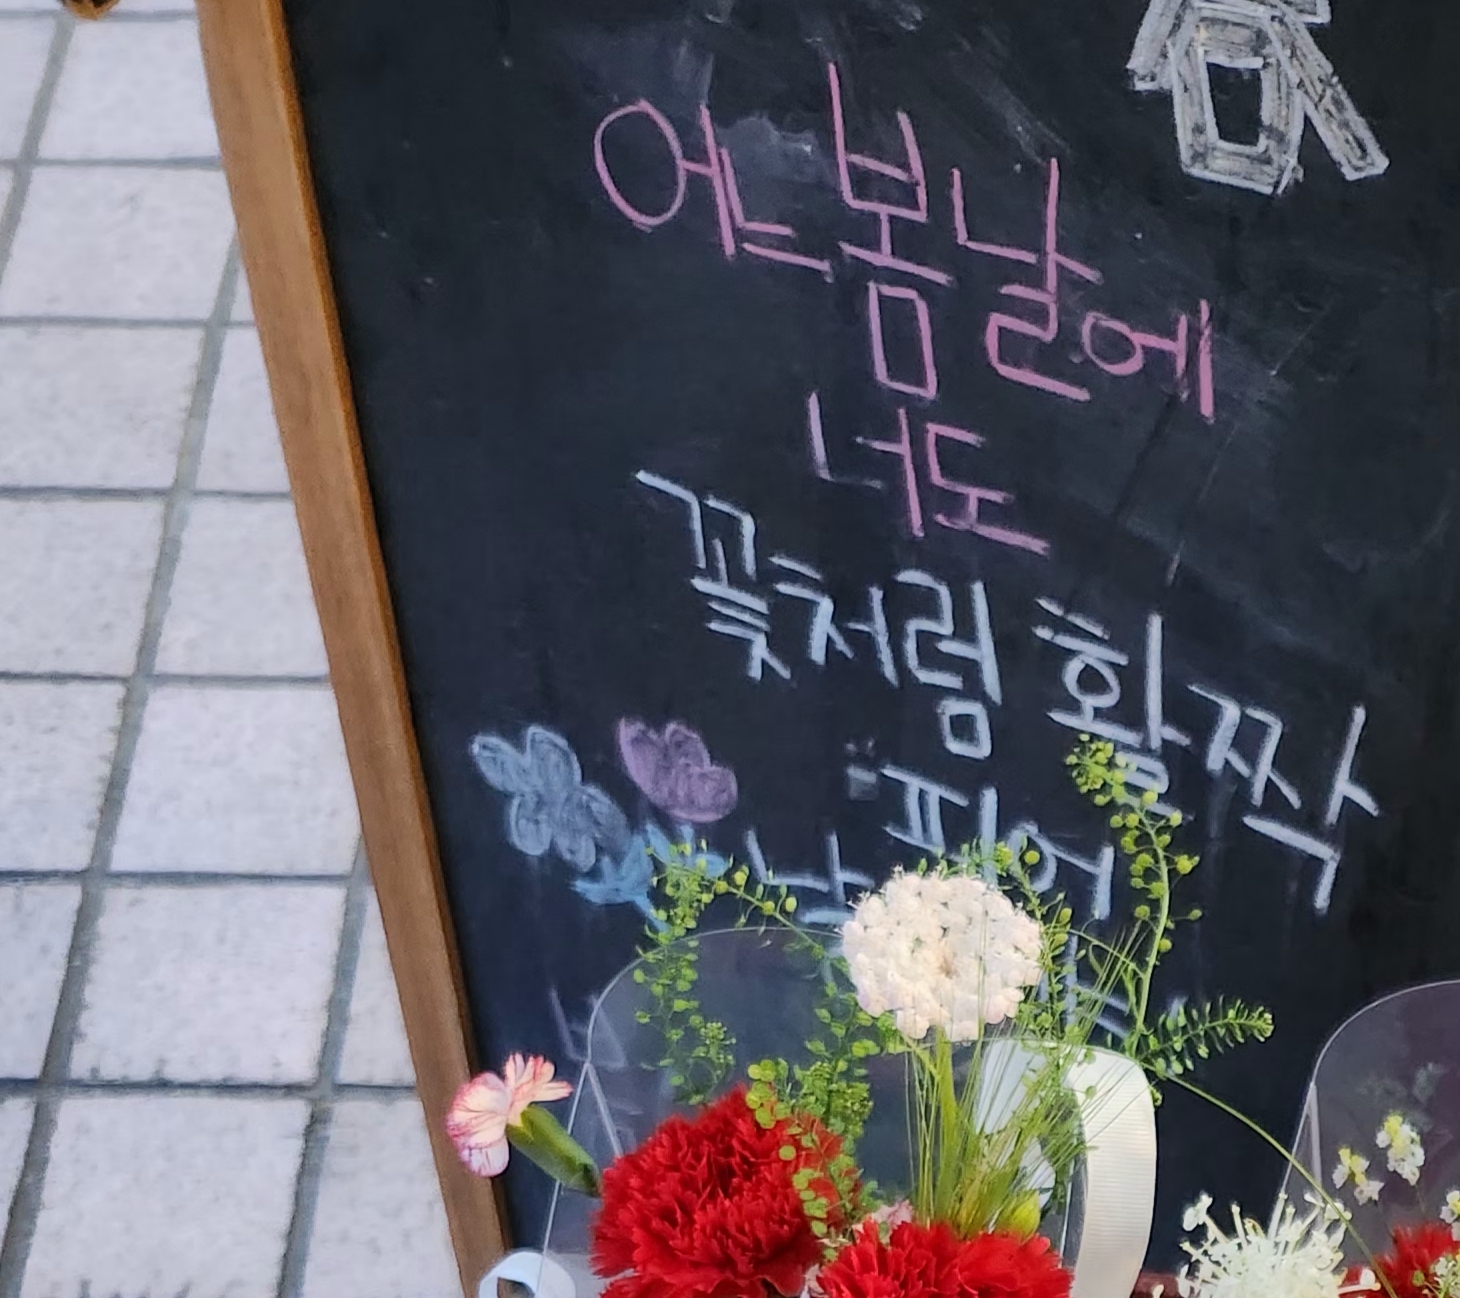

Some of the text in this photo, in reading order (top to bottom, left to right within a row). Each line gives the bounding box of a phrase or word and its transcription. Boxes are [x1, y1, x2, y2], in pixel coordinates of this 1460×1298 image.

[829, 60, 1215, 424] 봄날에
[633, 467, 1001, 762] 꽃처럼
[809, 390, 1051, 558] 너도
